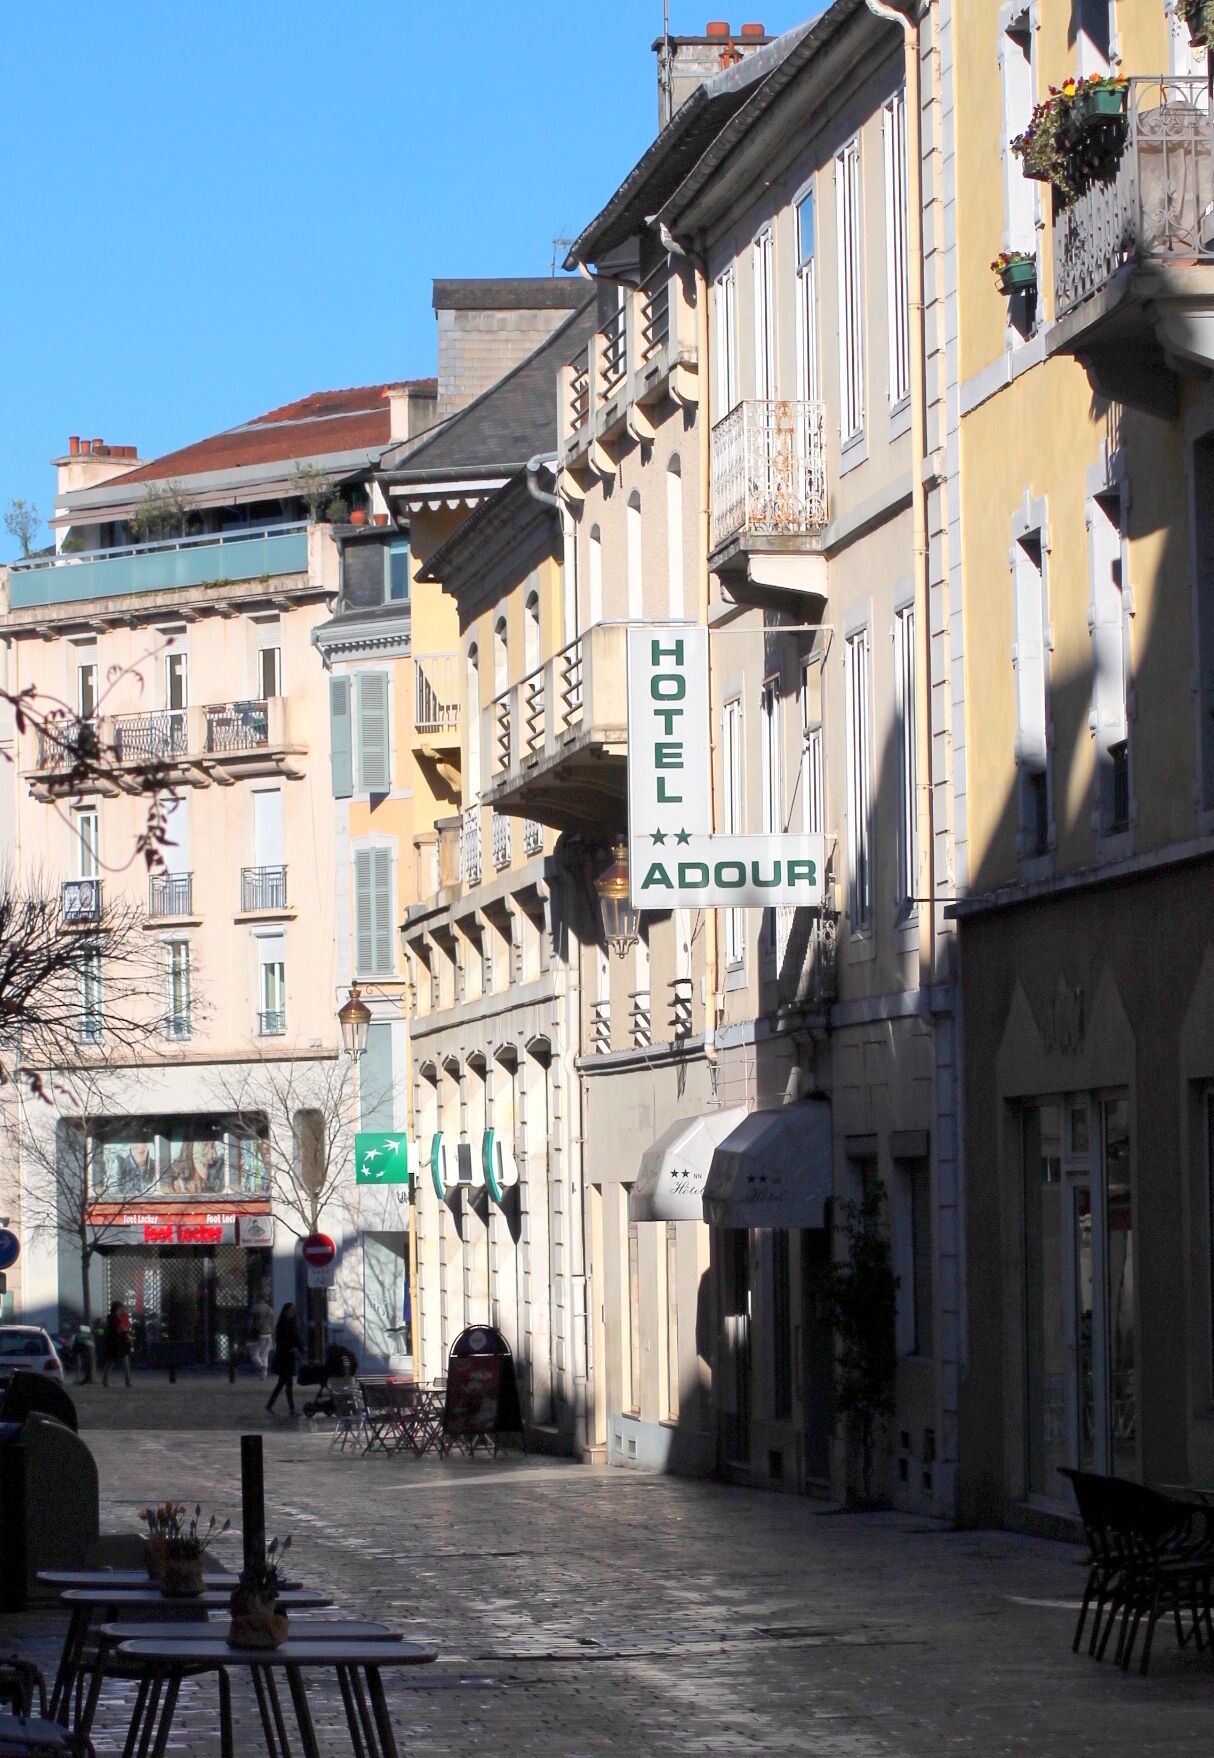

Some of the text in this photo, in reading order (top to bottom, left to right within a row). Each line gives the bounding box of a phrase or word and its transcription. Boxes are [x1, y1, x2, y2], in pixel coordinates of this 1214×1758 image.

[650, 639, 686, 803] HOTEL
[641, 860, 816, 889] ADOUR
[144, 1224, 223, 1243] Foot Locker
